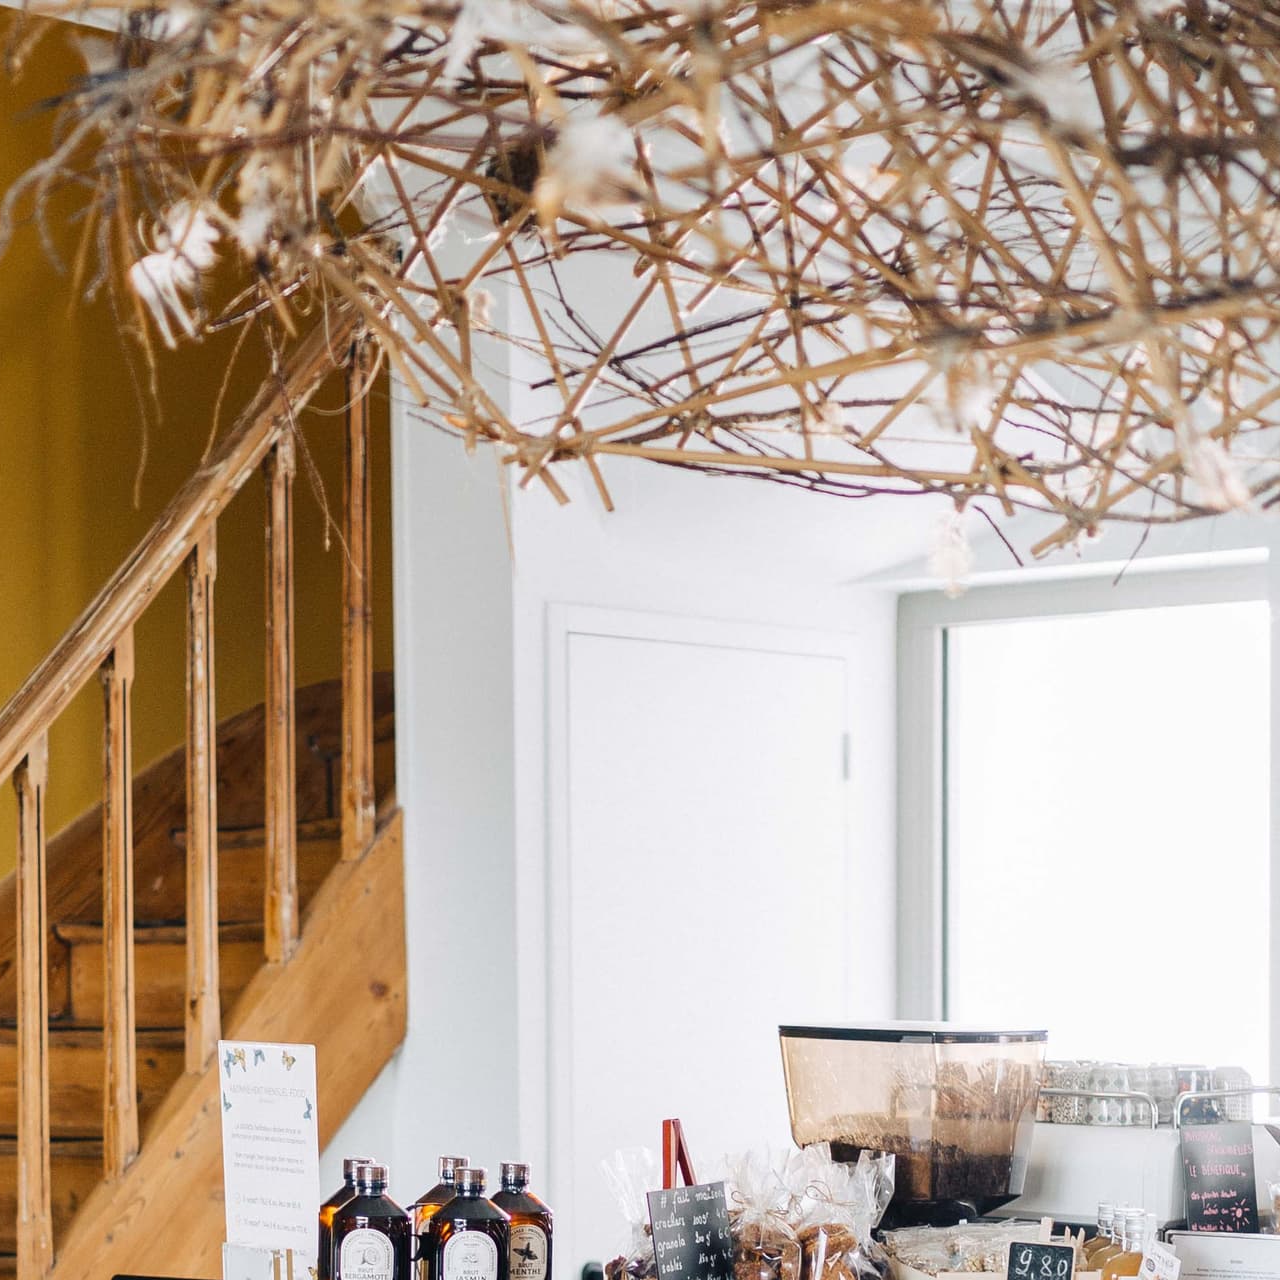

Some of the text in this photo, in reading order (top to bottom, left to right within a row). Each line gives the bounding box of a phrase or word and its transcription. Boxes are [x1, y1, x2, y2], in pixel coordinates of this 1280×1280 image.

[657, 1234, 686, 1258] granola
[344, 1272, 388, 1280] BERGAMOTE
[509, 1268, 542, 1276] MENTHE
